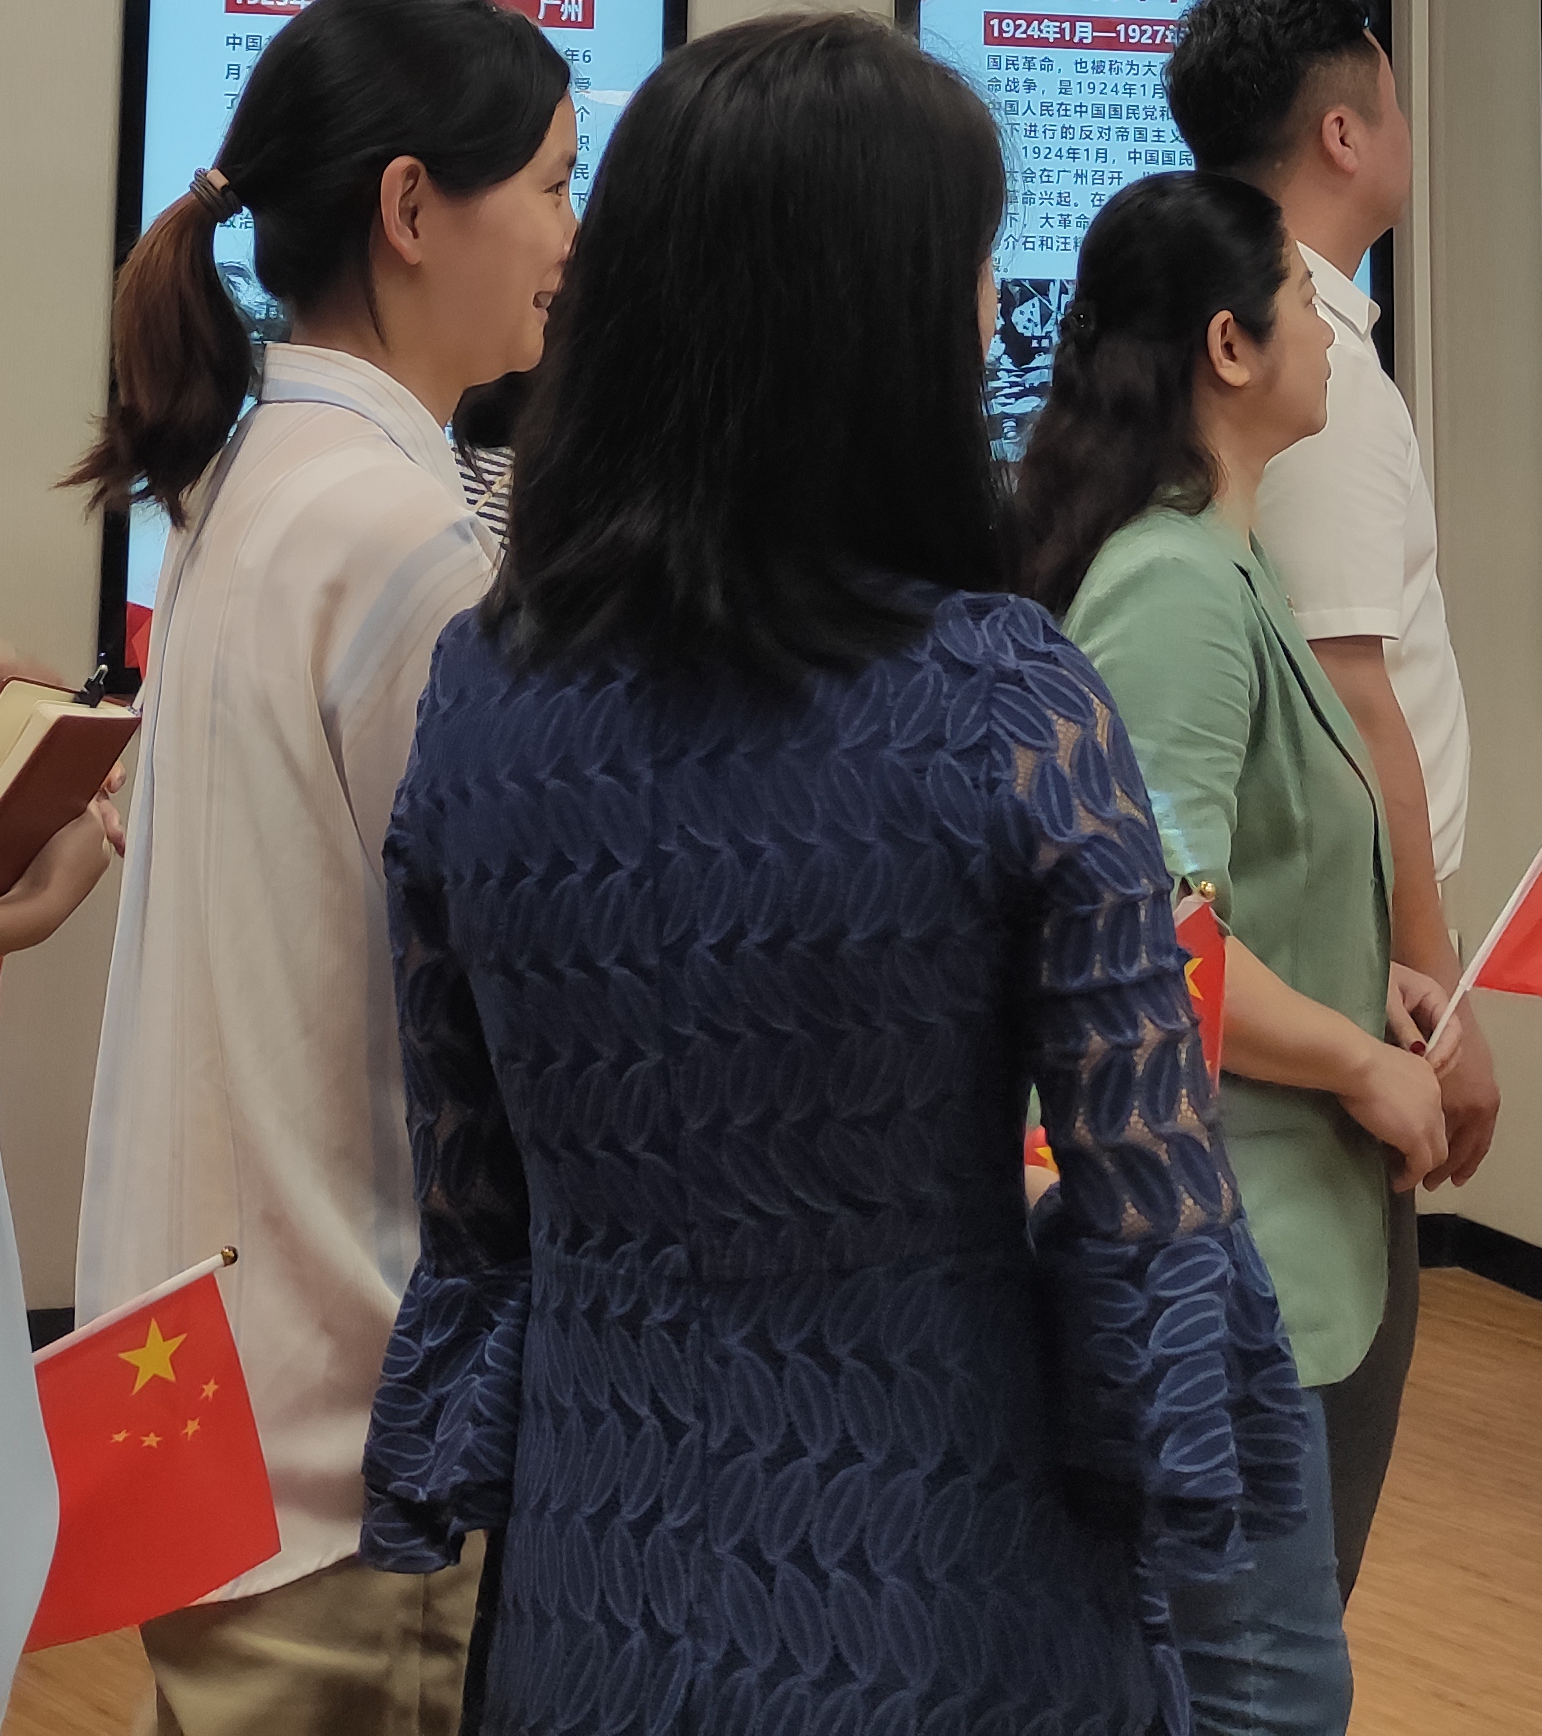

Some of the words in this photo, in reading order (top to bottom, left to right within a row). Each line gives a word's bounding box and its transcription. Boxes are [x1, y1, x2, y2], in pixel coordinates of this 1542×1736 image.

[225, 33, 273, 52] 中国
[564, 47, 592, 64] 年6
[987, 54, 1165, 77] 国民革命，也被称为大
[1007, 189, 1110, 208] 革命兴起。在
